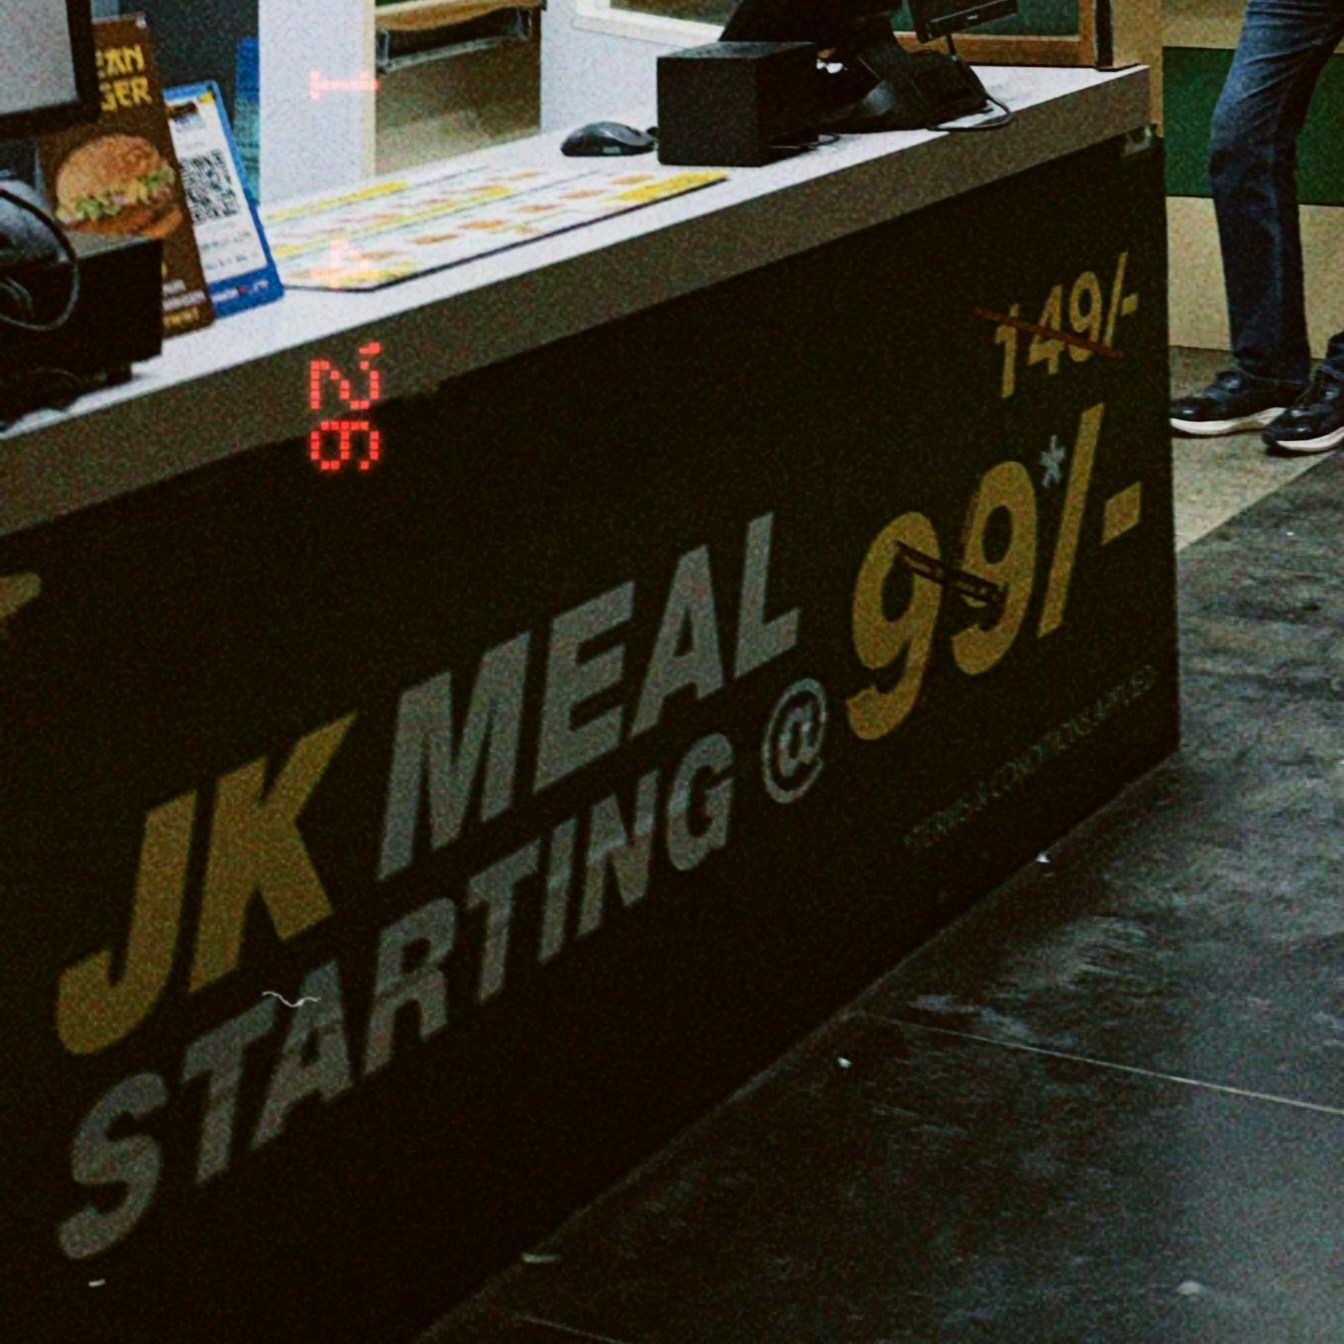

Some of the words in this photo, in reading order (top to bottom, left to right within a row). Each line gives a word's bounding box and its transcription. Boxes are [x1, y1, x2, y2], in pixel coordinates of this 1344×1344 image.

[994, 251, 1140, 399] 149/-
[54, 712, 357, 1055] JK
[377, 512, 802, 881] MEAL
[56, 731, 736, 1261] STARTING
[760, 676, 829, 805] @
